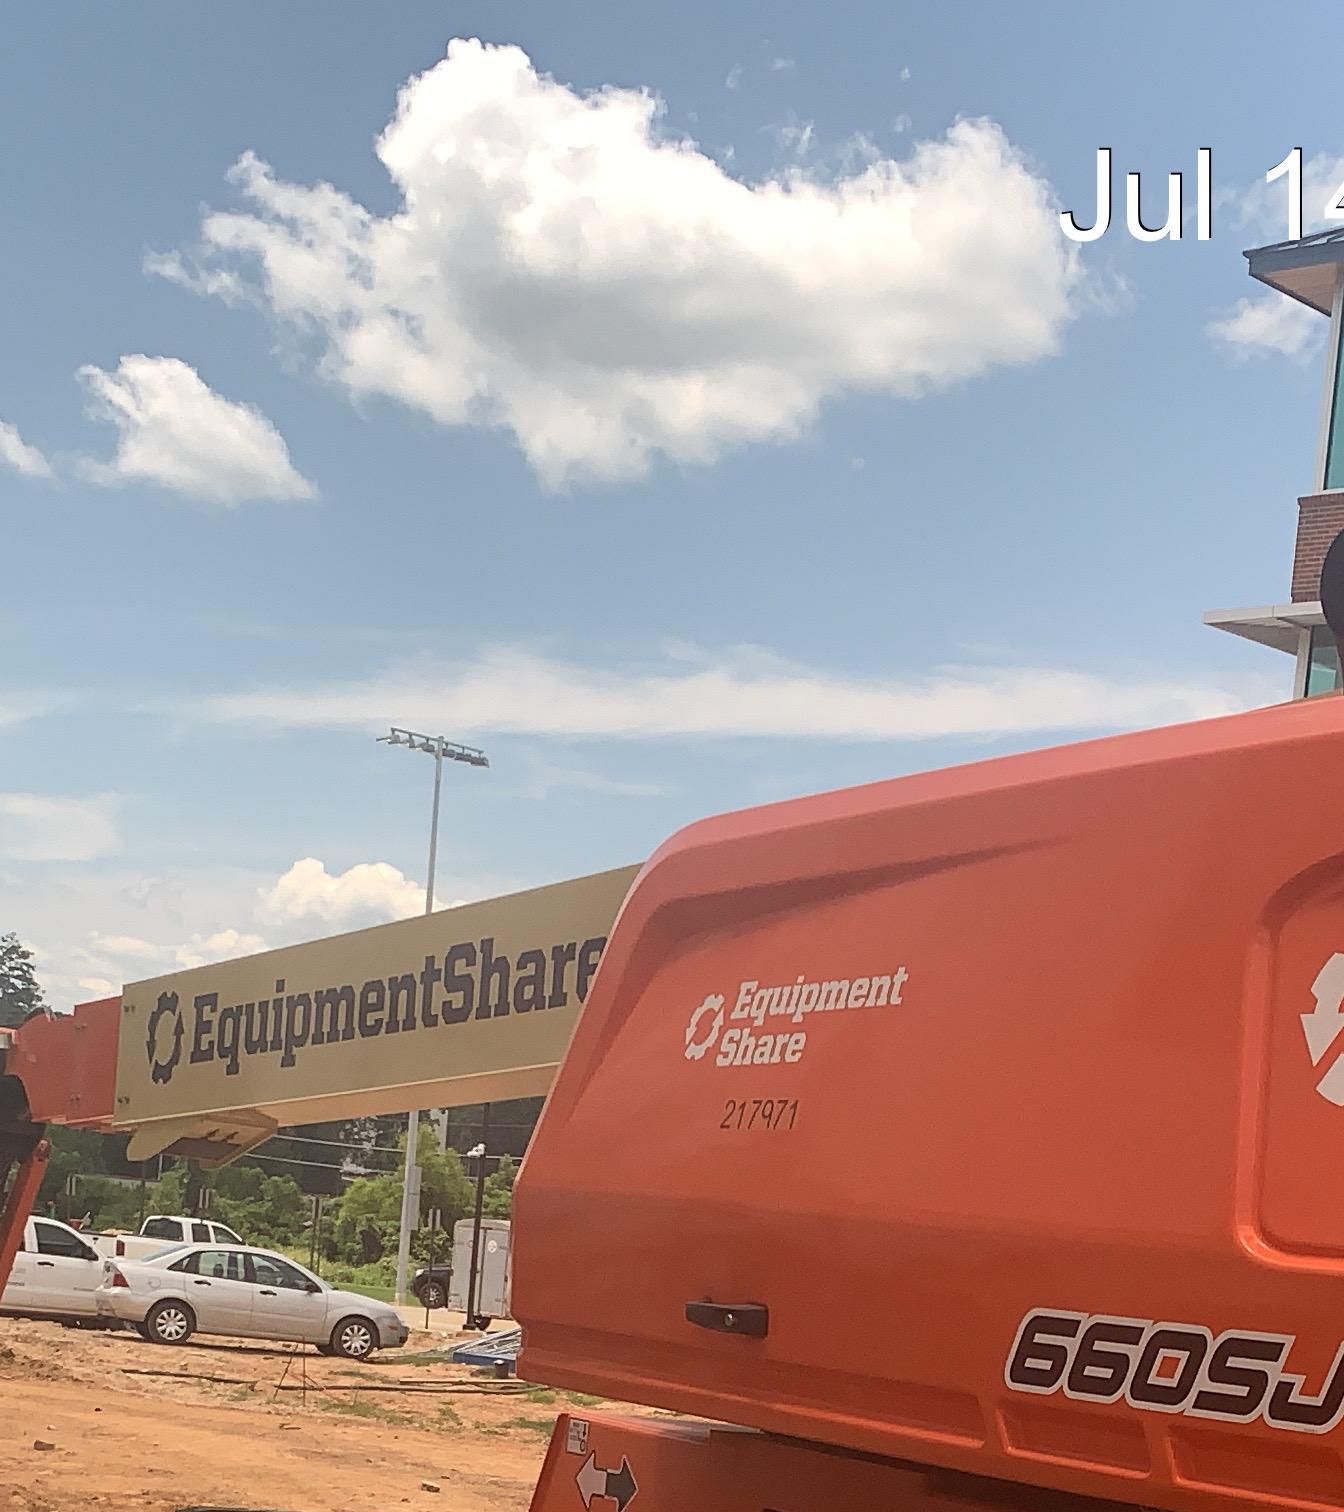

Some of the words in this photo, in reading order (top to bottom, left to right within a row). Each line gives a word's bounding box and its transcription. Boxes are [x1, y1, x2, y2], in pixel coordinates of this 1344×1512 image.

[189, 937, 608, 1076] EquipmentShare
[730, 966, 909, 1027] Equipment
[716, 1026, 807, 1067] Share
[719, 1099, 800, 1131] 217971
